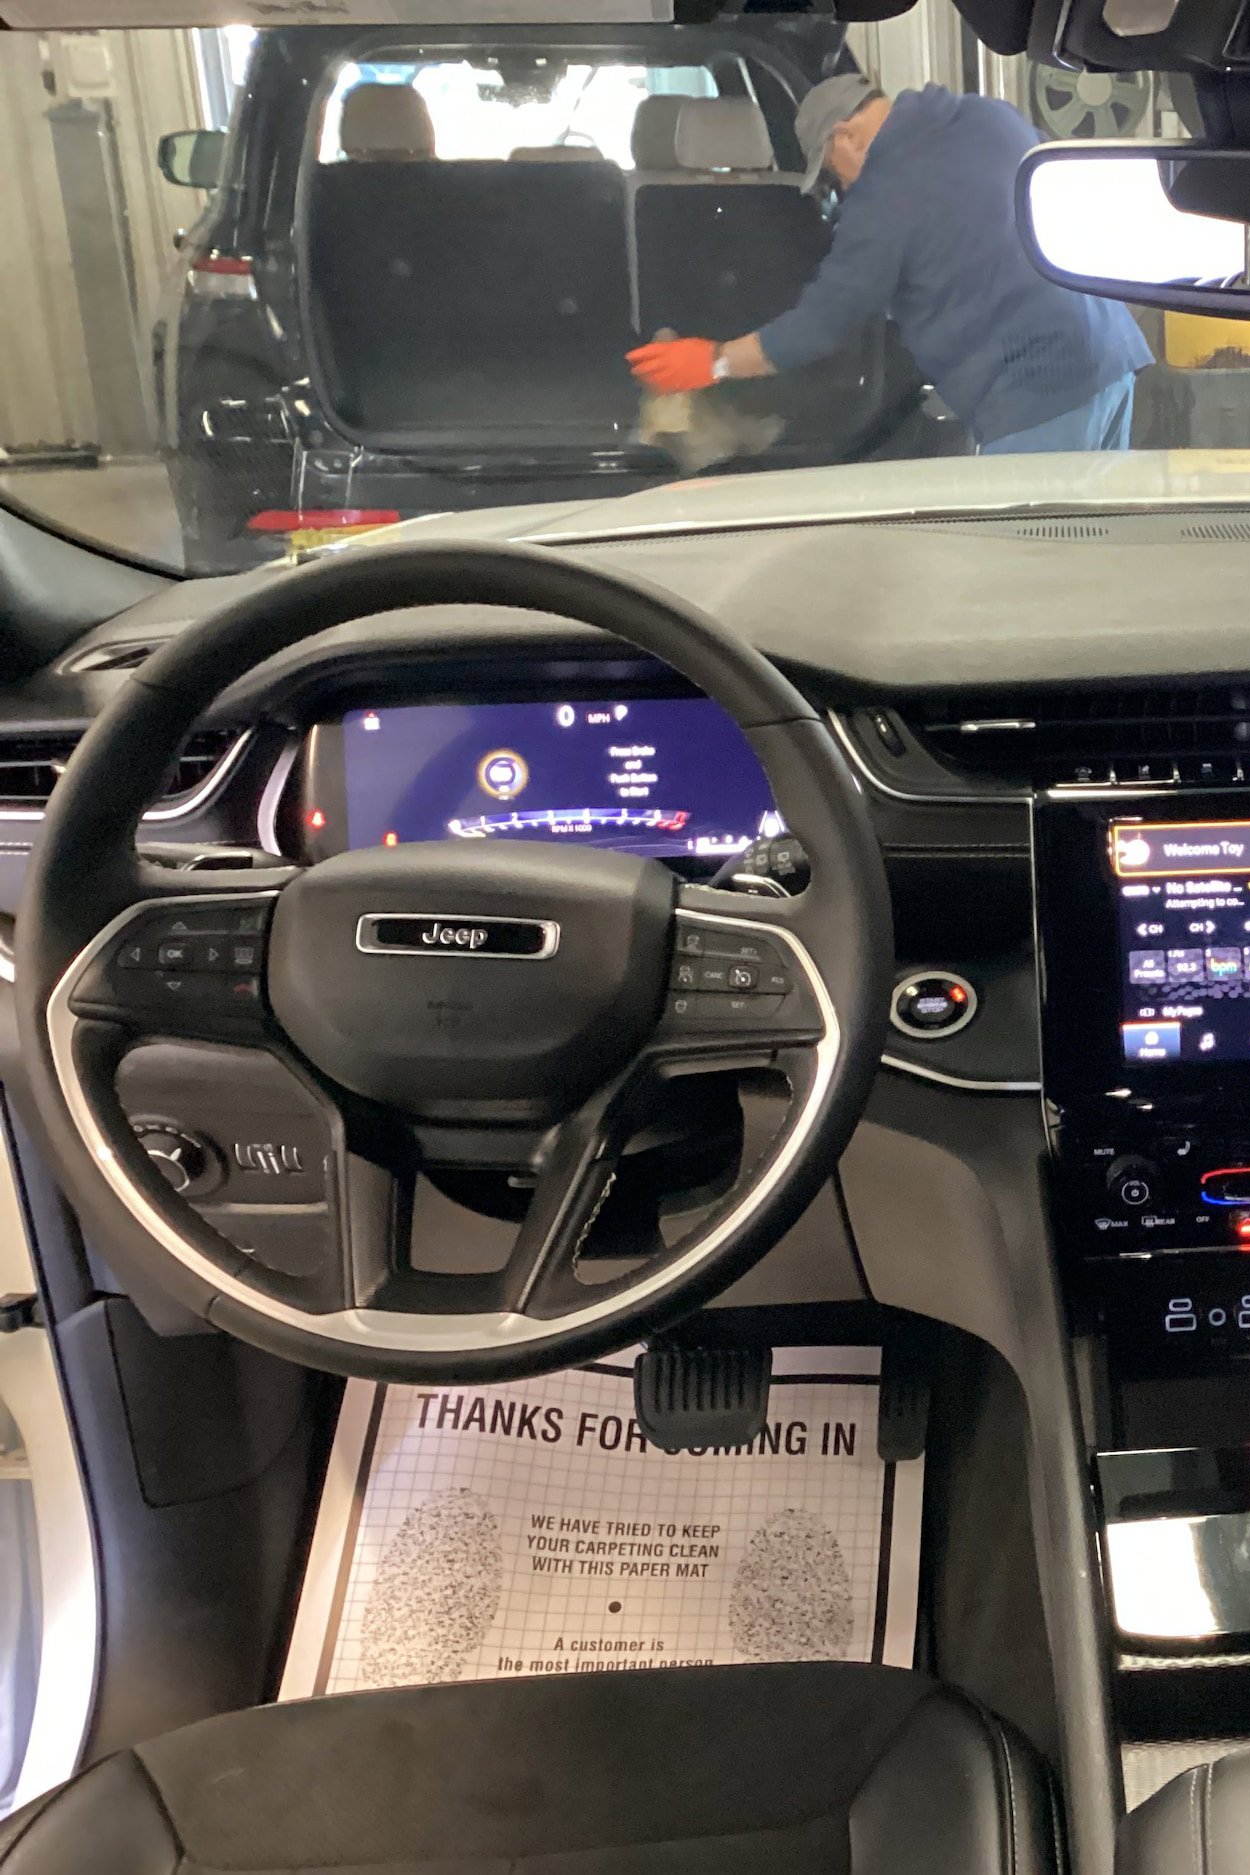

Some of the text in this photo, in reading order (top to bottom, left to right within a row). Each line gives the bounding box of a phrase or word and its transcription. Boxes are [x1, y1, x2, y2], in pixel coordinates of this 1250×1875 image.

[558, 705, 610, 727] 0 MPH
[1163, 843, 1219, 857] Welcome
[1165, 898, 1215, 910] Attempting
[1215, 898, 1226, 907] to
[421, 922, 489, 950] Jeep
[166, 949, 184, 959] OK
[1210, 958, 1237, 977] bpm
[1110, 1220, 1129, 1228] MAX
[1195, 1216, 1210, 1224] OFF
[417, 1393, 564, 1444] THANKS
[576, 1411, 648, 1453] FOR
[821, 1422, 857, 1456] IN
[531, 1514, 721, 1539] WE HAVE TRIED TO KEEP
[527, 1535, 720, 1559] YOUR CARPETING CLEAN
[532, 1556, 710, 1578] WITH THIS PAPER MAT
[553, 1636, 665, 1652] A customer is
[497, 1656, 524, 1672] the
[529, 1657, 570, 1672] most
[575, 1657, 654, 1672] important
